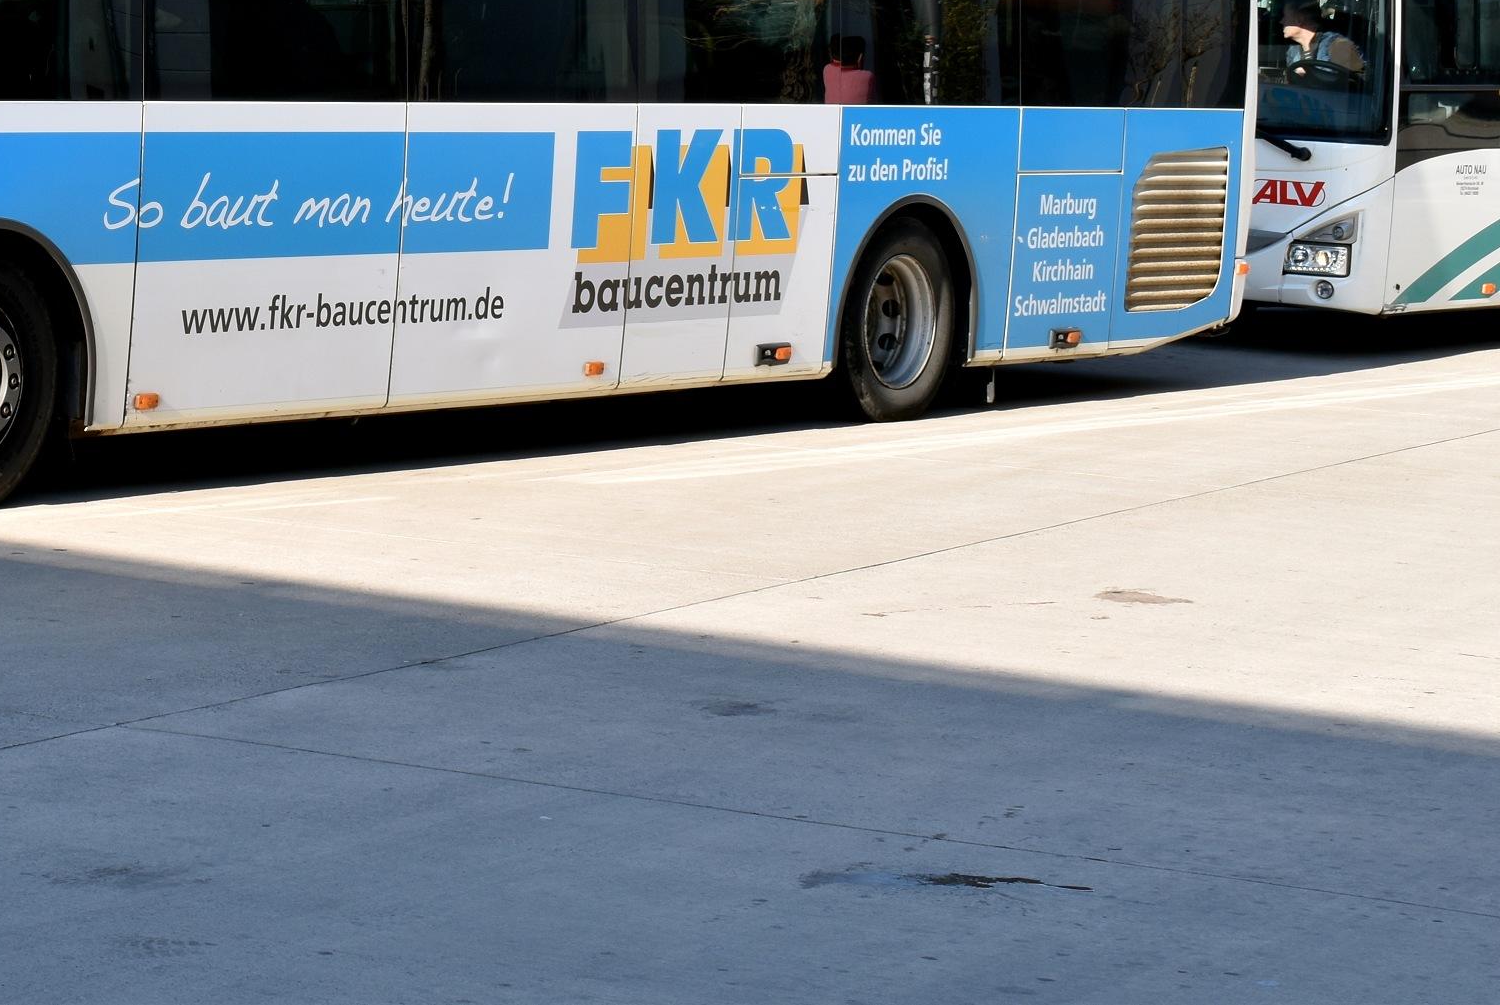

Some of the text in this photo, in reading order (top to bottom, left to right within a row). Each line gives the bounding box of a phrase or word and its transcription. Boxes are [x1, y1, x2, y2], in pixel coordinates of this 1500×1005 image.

[850, 122, 942, 147] Kommen Sie
[848, 157, 949, 183] zu den Profis!
[1455, 164, 1473, 175] AUTO
[103, 172, 515, 231] So baut man heute!
[571, 129, 796, 250] FKR
[1253, 179, 1326, 207] ALV
[1039, 193, 1097, 220] Marburg
[1027, 225, 1104, 249] Gladenbach
[1032, 258, 1094, 283] Kirchhain
[572, 264, 782, 314] baucentrum
[181, 286, 505, 335] www.fkr-baucentrum.de
[1014, 290, 1106, 317] Schwalmstadt
